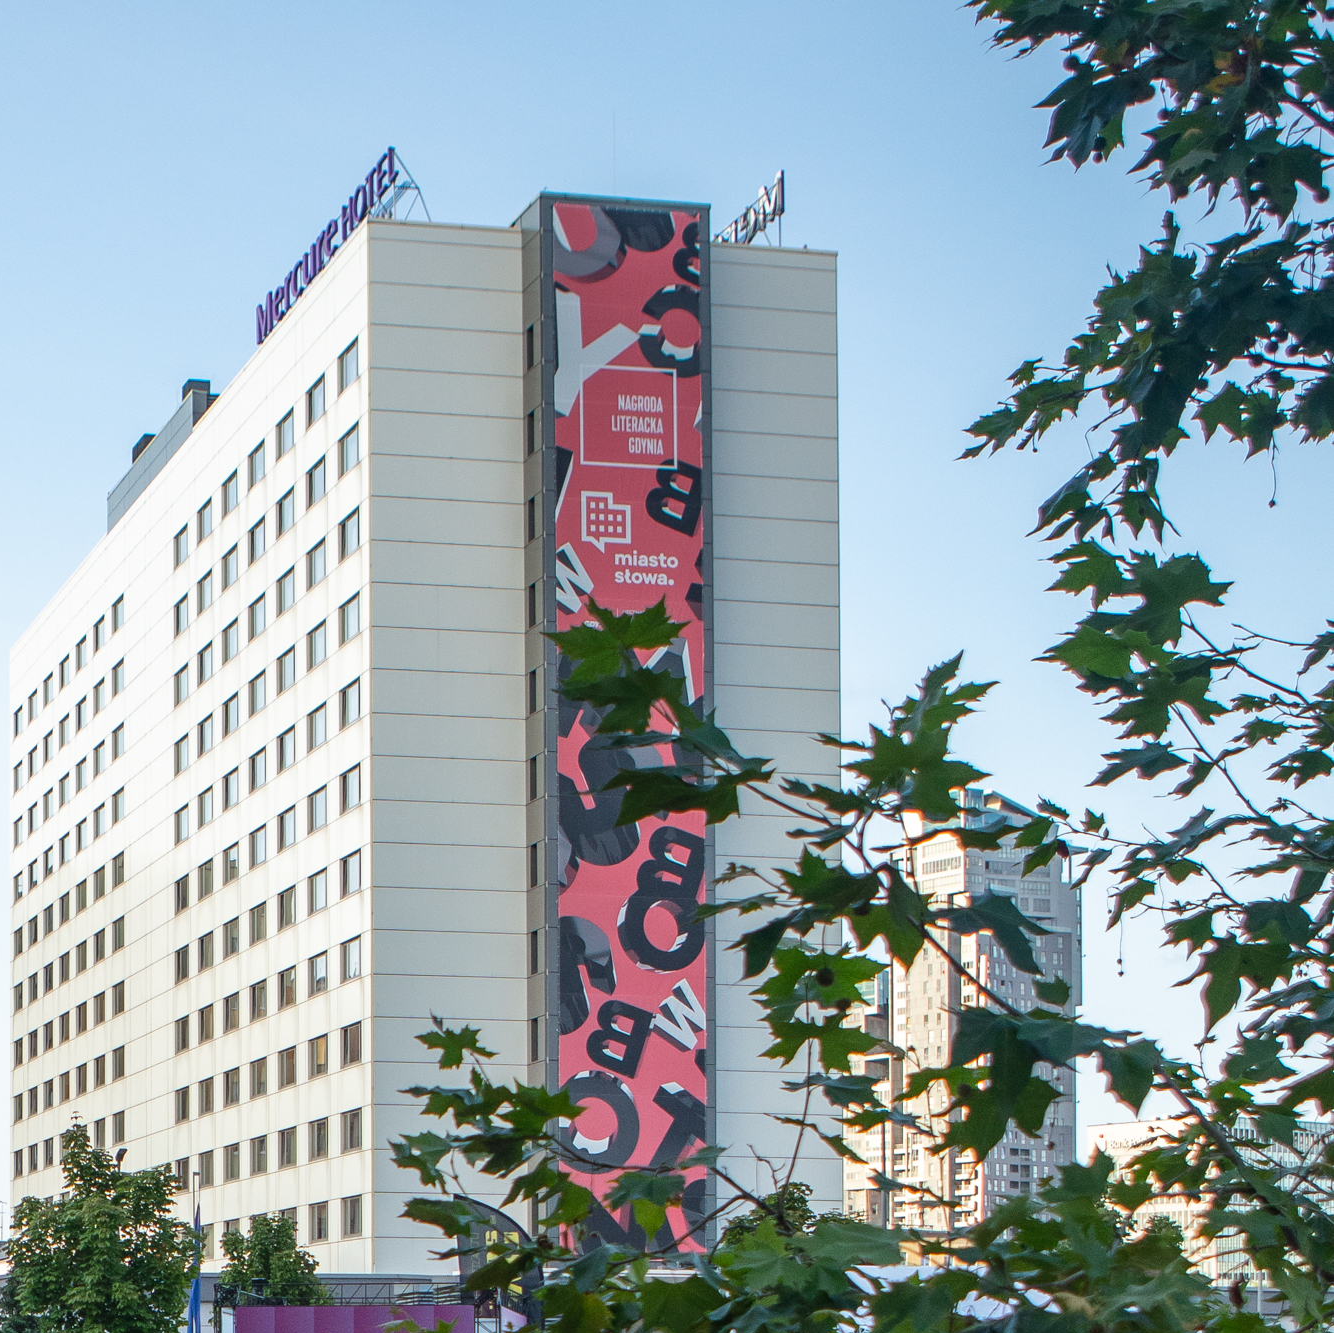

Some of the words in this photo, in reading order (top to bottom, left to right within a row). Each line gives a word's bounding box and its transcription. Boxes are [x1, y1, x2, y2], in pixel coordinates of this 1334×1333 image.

[256, 219, 339, 345] Mercure
[341, 146, 399, 242] HOTEL
[618, 394, 663, 413] NAGRODA
[611, 415, 663, 434] LITERACKA
[628, 437, 663, 455] GDYNIA
[614, 550, 678, 569] miasto
[614, 569, 675, 586] słowa.
